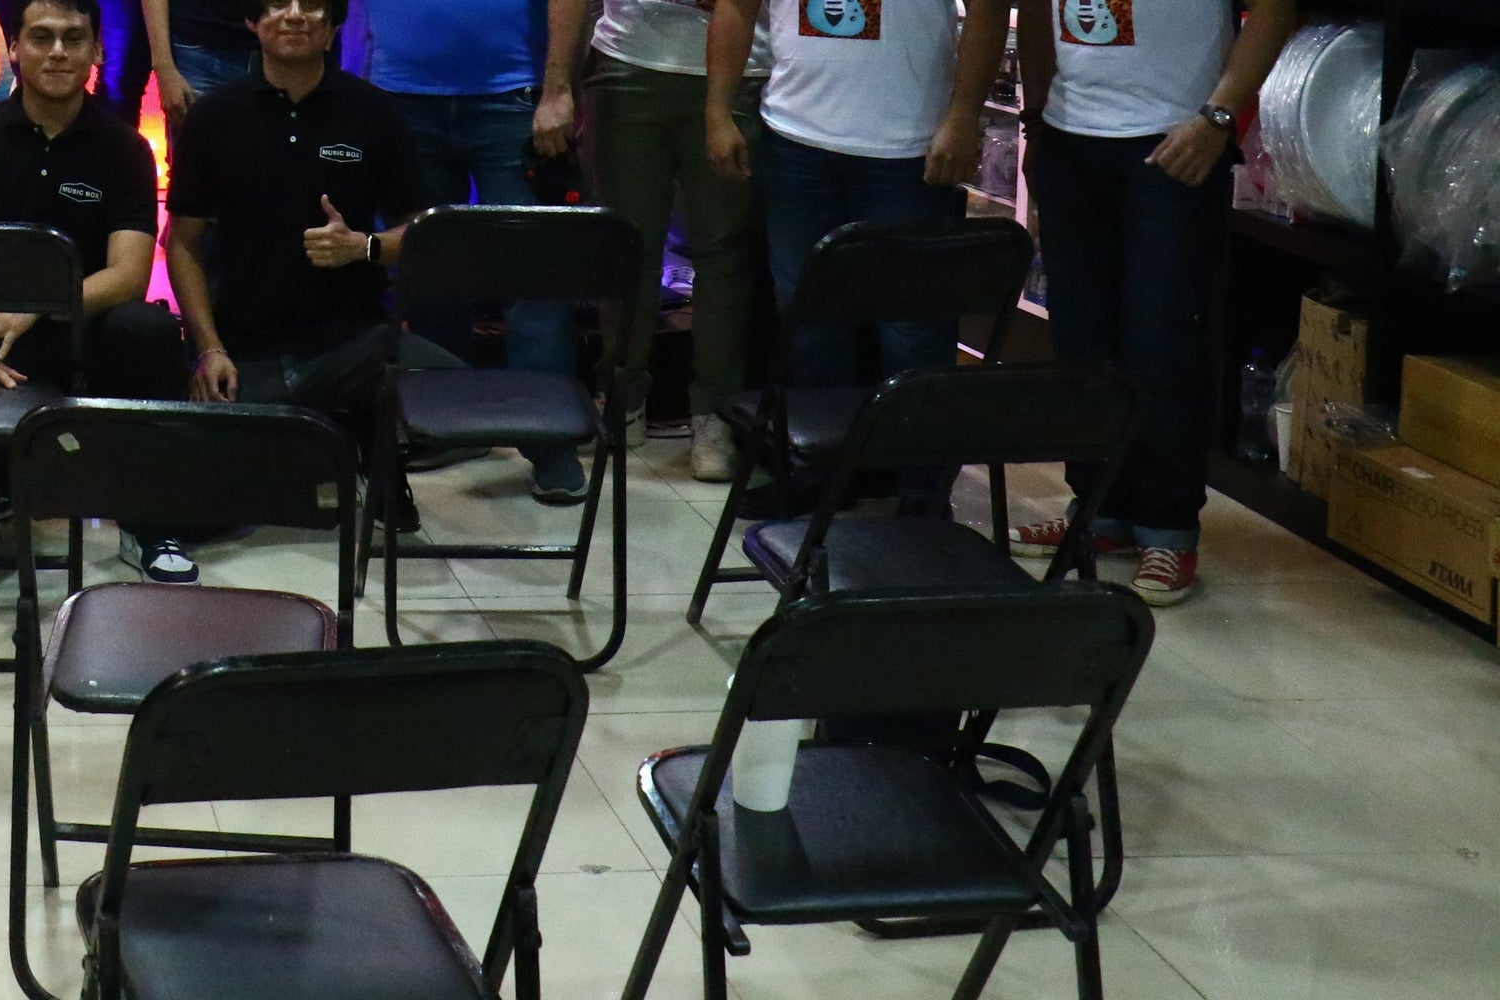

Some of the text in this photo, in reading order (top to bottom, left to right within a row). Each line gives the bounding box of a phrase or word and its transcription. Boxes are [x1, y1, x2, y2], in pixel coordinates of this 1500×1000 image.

[321, 149, 360, 158] MUSIC BOX
[61, 186, 100, 199] MUSIC BOX
[1352, 461, 1396, 497] CHAIR
[1437, 563, 1473, 598] TAMA
